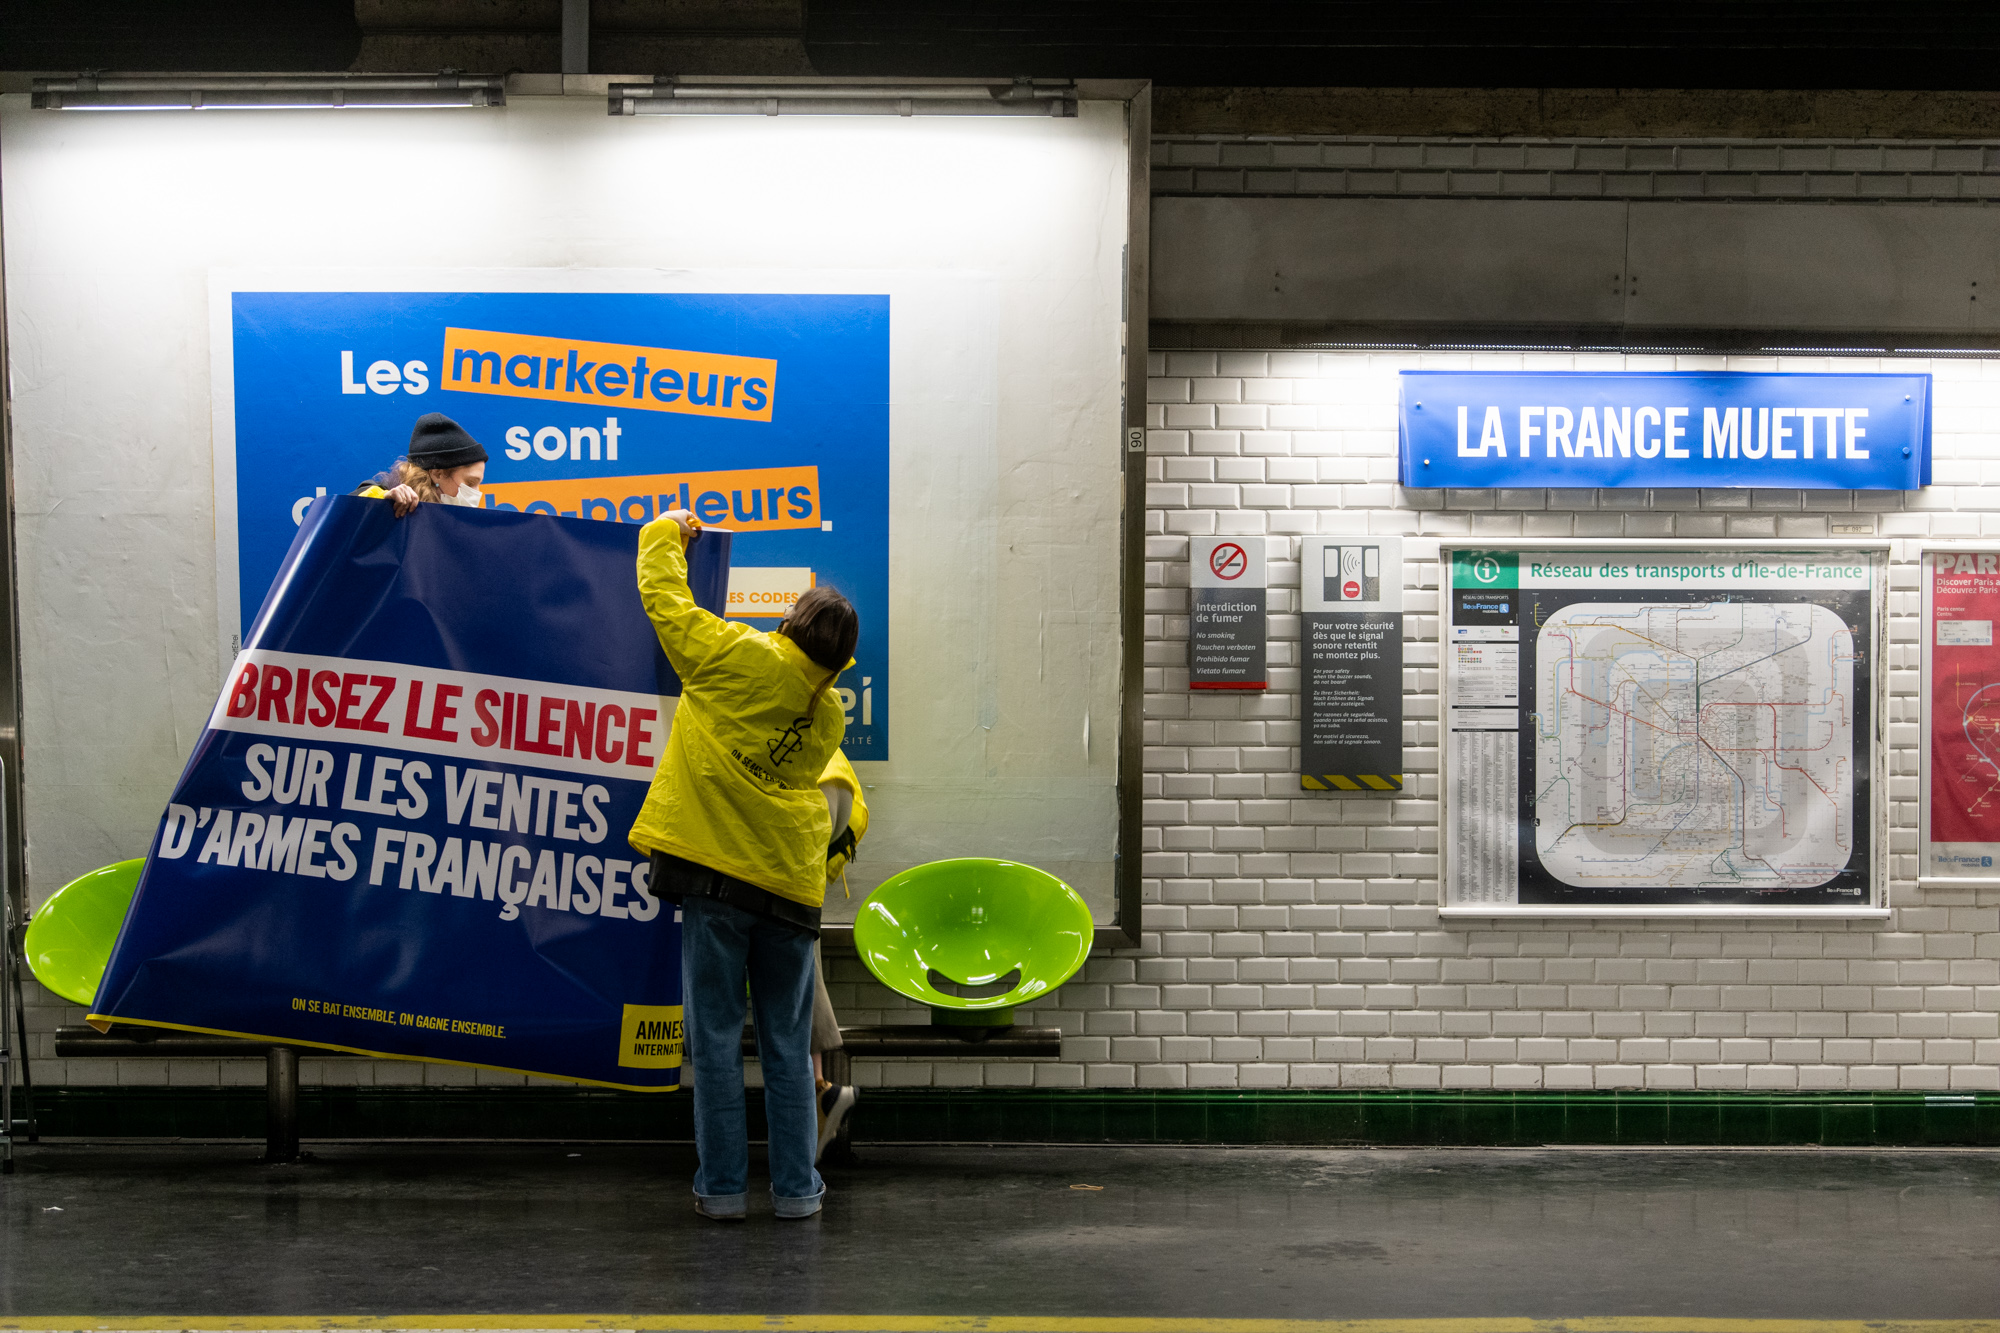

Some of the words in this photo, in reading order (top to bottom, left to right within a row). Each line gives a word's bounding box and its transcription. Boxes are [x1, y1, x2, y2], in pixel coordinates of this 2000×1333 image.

[341, 350, 429, 395] Les
[450, 345, 768, 412] marketeurs
[1456, 405, 1506, 458] LA
[1519, 405, 1690, 460] FRANCE
[1702, 407, 1870, 460] MUETTE
[505, 416, 621, 461] sont
[1936, 553, 2000, 574] PAR
[1530, 562, 1592, 578] Réseau
[1600, 562, 1629, 578] des
[1635, 563, 1725, 581] transports
[1732, 559, 1863, 579] d'Île-de-France
[1936, 578, 1971, 586] Discover
[1973, 578, 1994, 586] Paris
[1936, 586, 1977, 594] Découvrez
[1978, 586, 1998, 594] Paris
[749, 592, 799, 604] CODES
[1196, 602, 1257, 612] Interdiction
[1196, 613, 1209, 623] de
[1211, 613, 1243, 623] fumer
[1313, 622, 1333, 630] Pour
[1335, 622, 1358, 630] votre
[1360, 621, 1394, 630] sécurité
[1207, 631, 1236, 640] smoking
[1313, 631, 1328, 640] dès
[1330, 633, 1346, 641] que
[1348, 631, 1356, 640] le
[1358, 631, 1384, 641] signal
[1196, 643, 1225, 651] Rauchen
[1226, 643, 1256, 651] verboten
[1313, 642, 1342, 650] sonore
[1344, 641, 1378, 650] retentit
[1196, 655, 1228, 663] Prohibido
[1229, 655, 1250, 663] fumar
[1326, 651, 1358, 659] montez
[1360, 651, 1381, 660] plus.
[1222, 667, 1246, 675] fumare
[226, 662, 397, 734] BRISEZ
[402, 680, 463, 743] LE
[470, 688, 657, 768] SILENCE
[241, 743, 334, 808] SUR
[341, 752, 433, 819] LES
[444, 765, 610, 844] VENTES
[157, 803, 361, 881] D'ARMES
[369, 827, 660, 922] FRANÇAISES
[292, 997, 306, 1011] ON
[308, 999, 321, 1013] SE
[323, 1001, 341, 1015] BAT
[343, 1004, 397, 1026] ENSEMBLE,
[399, 1012, 414, 1026] ON
[416, 1014, 450, 1031] GAGNE
[451, 1019, 507, 1039] ENSEMBLE.
